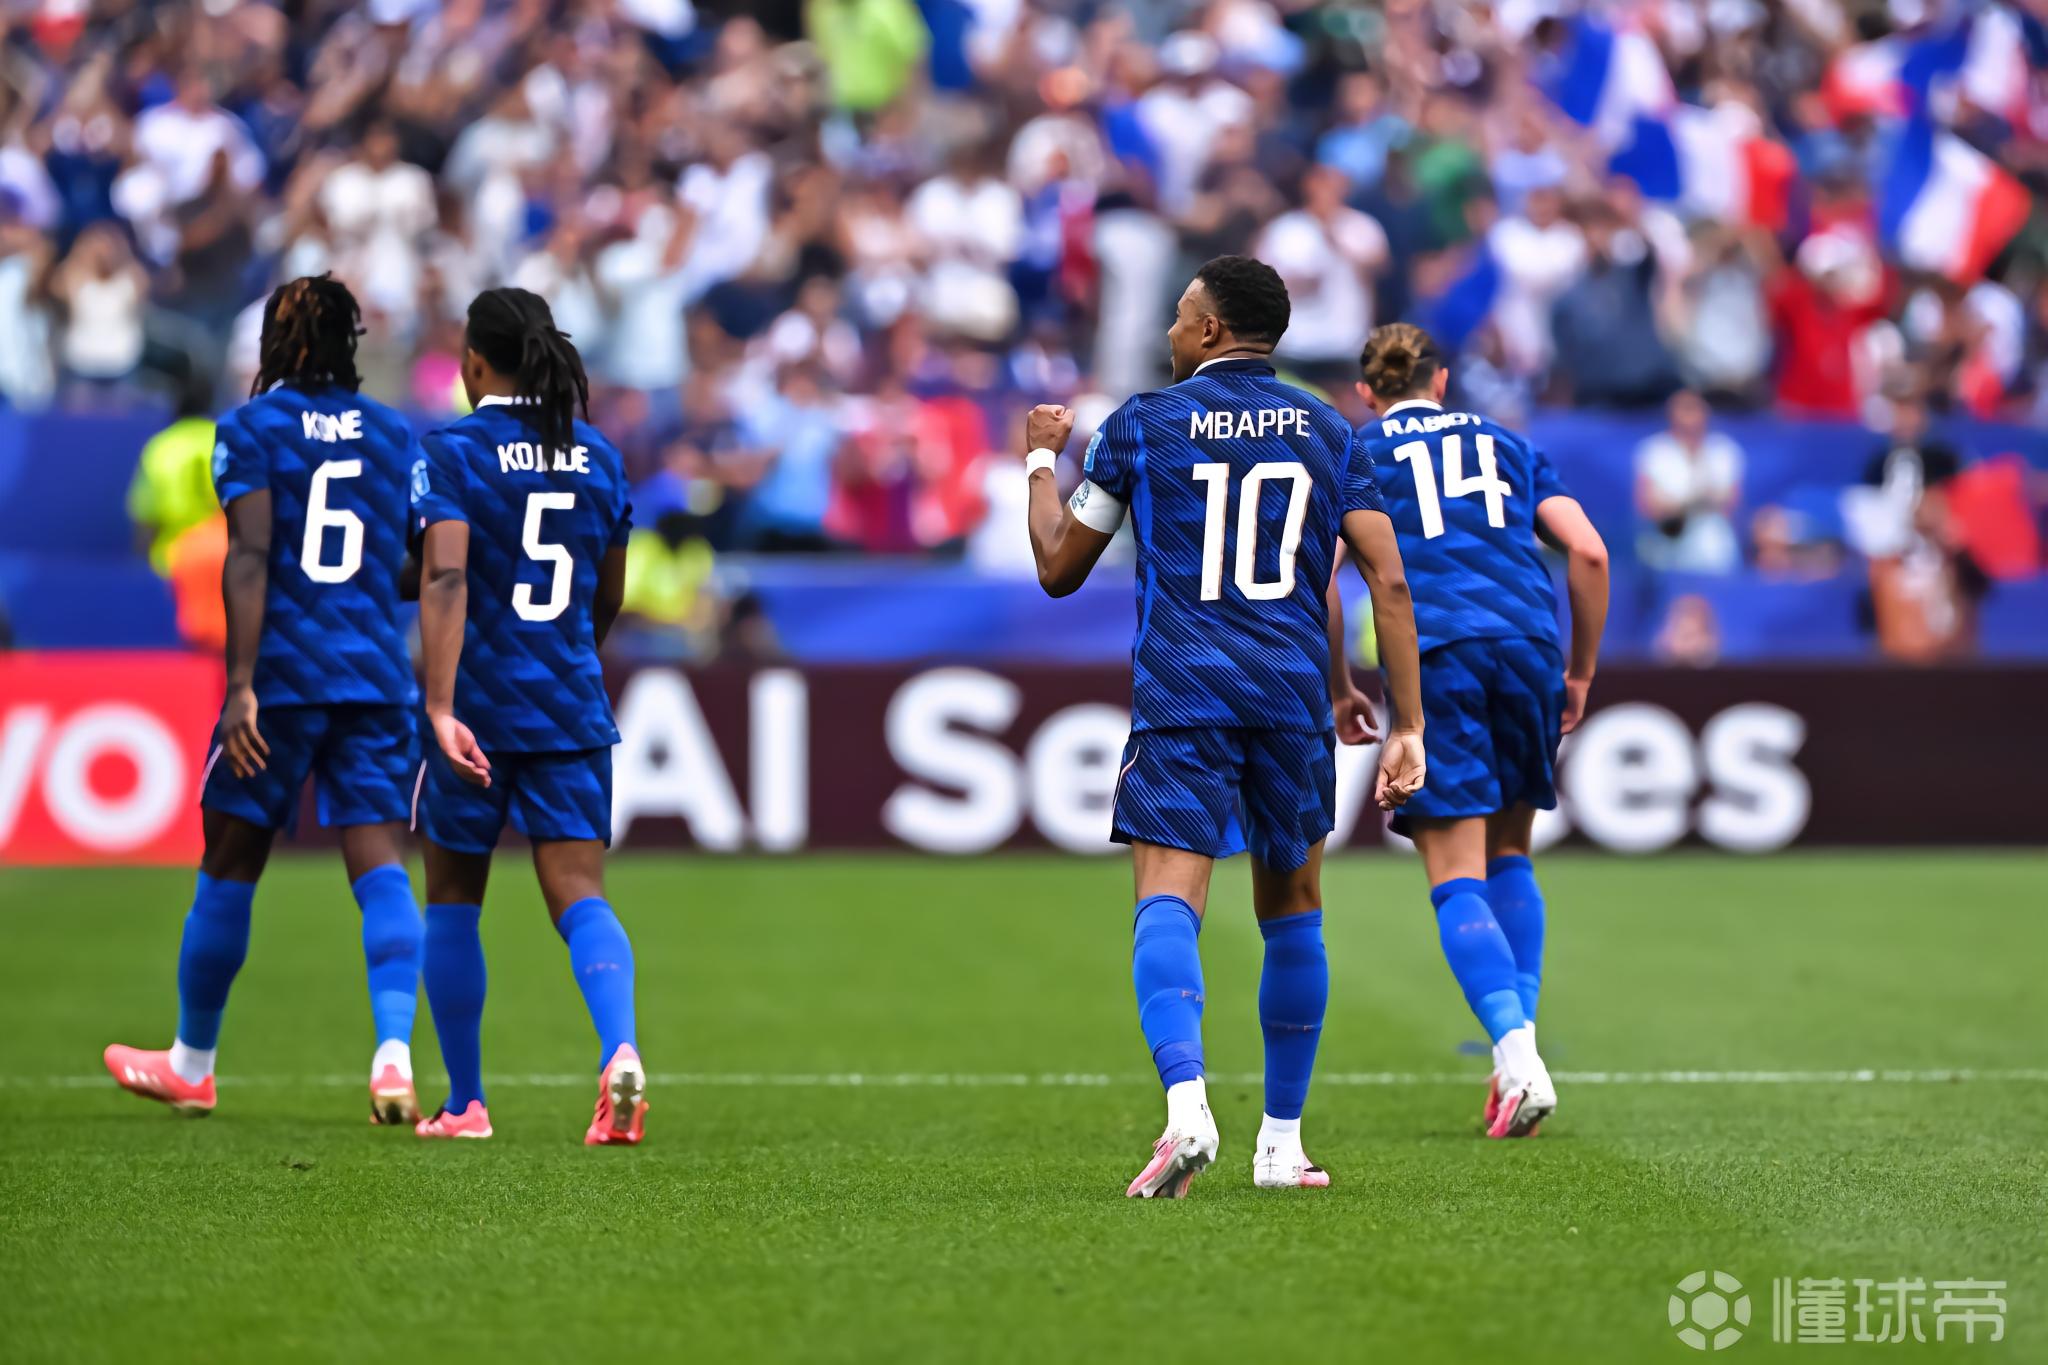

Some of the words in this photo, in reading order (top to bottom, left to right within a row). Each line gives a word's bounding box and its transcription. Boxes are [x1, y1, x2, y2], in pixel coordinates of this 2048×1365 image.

[301, 410, 363, 443] KONE
[497, 442, 590, 474] KODE
[1190, 408, 1310, 439] MBAPPE
[300, 459, 363, 583] 6
[1192, 461, 1313, 601] 10
[1393, 433, 1512, 540] 14
[511, 492, 576, 621] 5
[609, 668, 810, 852] AI
